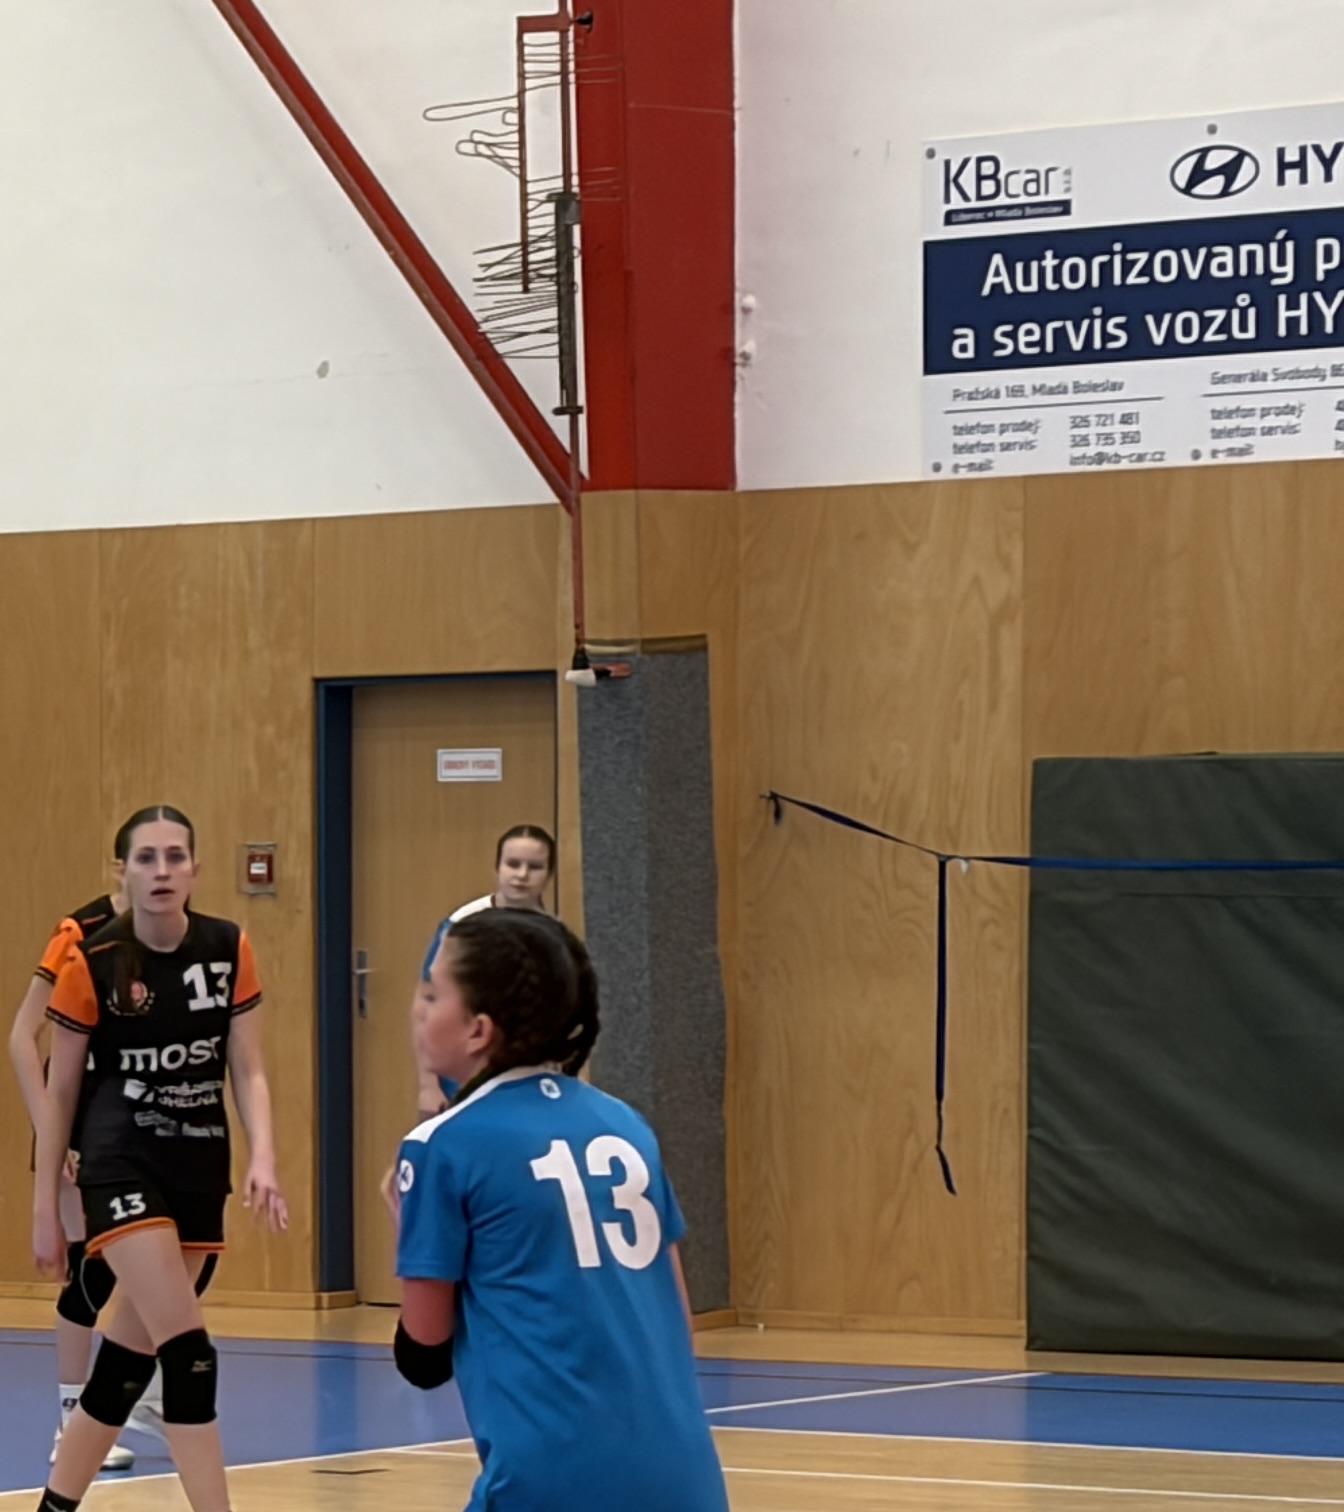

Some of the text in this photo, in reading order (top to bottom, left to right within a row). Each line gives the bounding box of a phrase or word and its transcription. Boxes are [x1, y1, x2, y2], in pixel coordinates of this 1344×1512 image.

[944, 155, 1059, 205] KBcar
[1277, 141, 1344, 187] HY
[981, 229, 1295, 296] Autorizovaný
[951, 290, 1344, 360] a servis vozů HY
[183, 962, 232, 1012] 13
[109, 1193, 147, 1220] 13
[529, 1134, 662, 1271] 13
